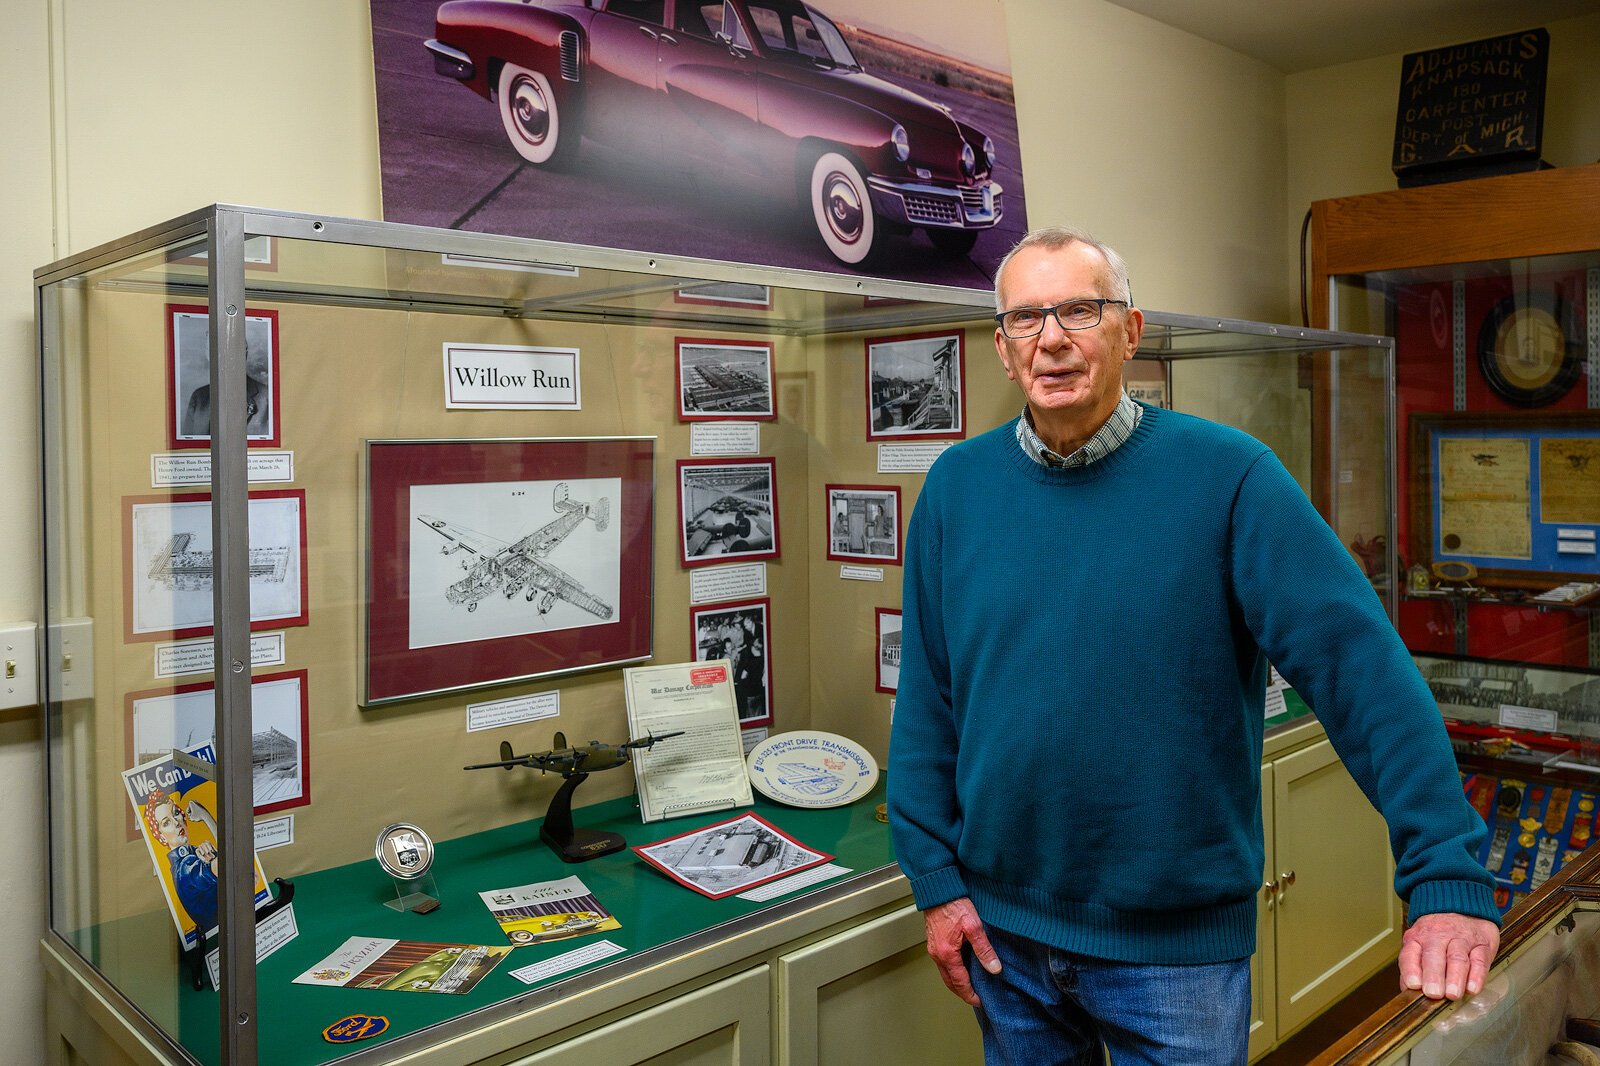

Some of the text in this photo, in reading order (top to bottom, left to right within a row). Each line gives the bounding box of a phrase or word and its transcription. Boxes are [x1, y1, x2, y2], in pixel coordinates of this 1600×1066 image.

[1406, 89, 1527, 122] CARPENTER
[1442, 113, 1487, 131] POST
[454, 367, 572, 389] Willow Run
[1129, 389, 1145, 399] CAR
[770, 738, 794, 752] FRONT
[795, 738, 818, 746] DRIVE
[822, 740, 868, 770] TRANSMISSIONS
[131, 775, 157, 799] We
[155, 766, 182, 788] Can
[522, 888, 573, 901] KAISER
[340, 939, 383, 970] FRAZER
[330, 1018, 362, 1037] Ford
